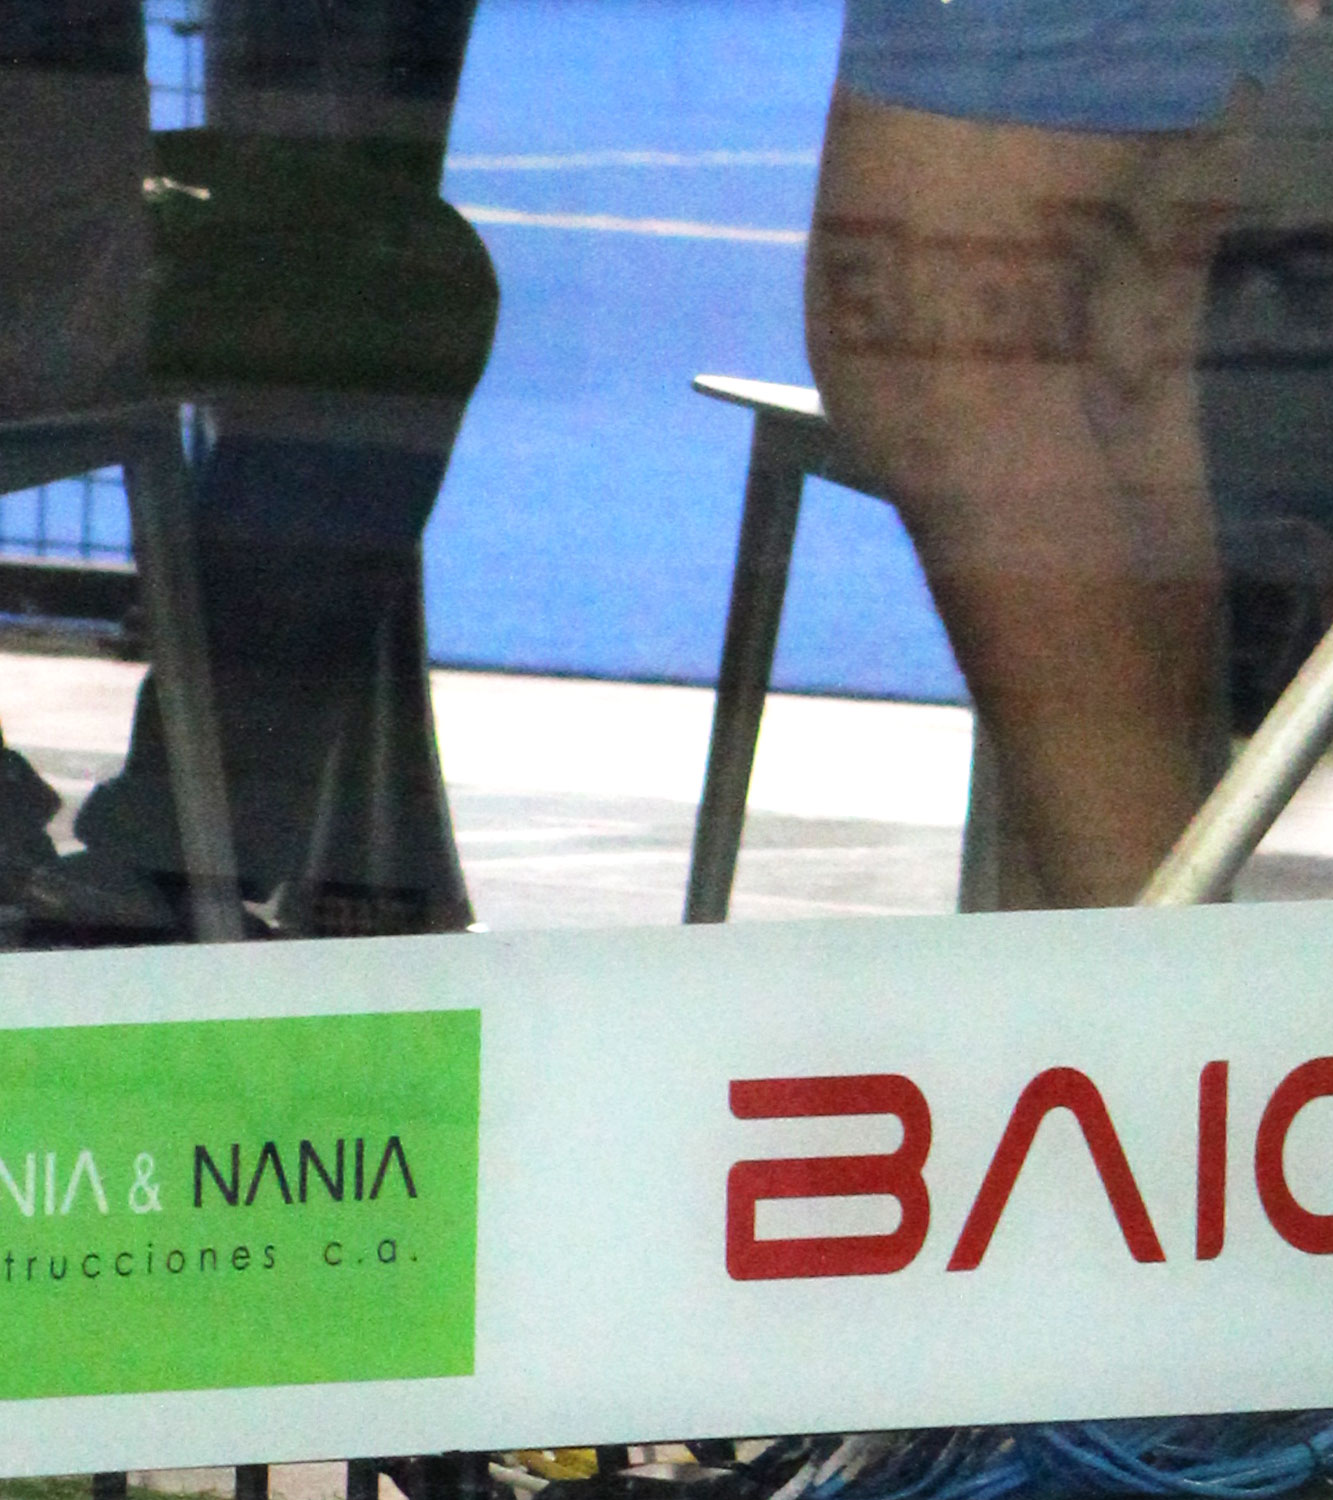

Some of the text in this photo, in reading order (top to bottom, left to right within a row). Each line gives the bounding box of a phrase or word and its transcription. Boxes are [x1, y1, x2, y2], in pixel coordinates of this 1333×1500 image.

[128, 1151, 163, 1215] &
[193, 1135, 418, 1209] NANIA
[323, 1237, 419, 1267] c.a.
